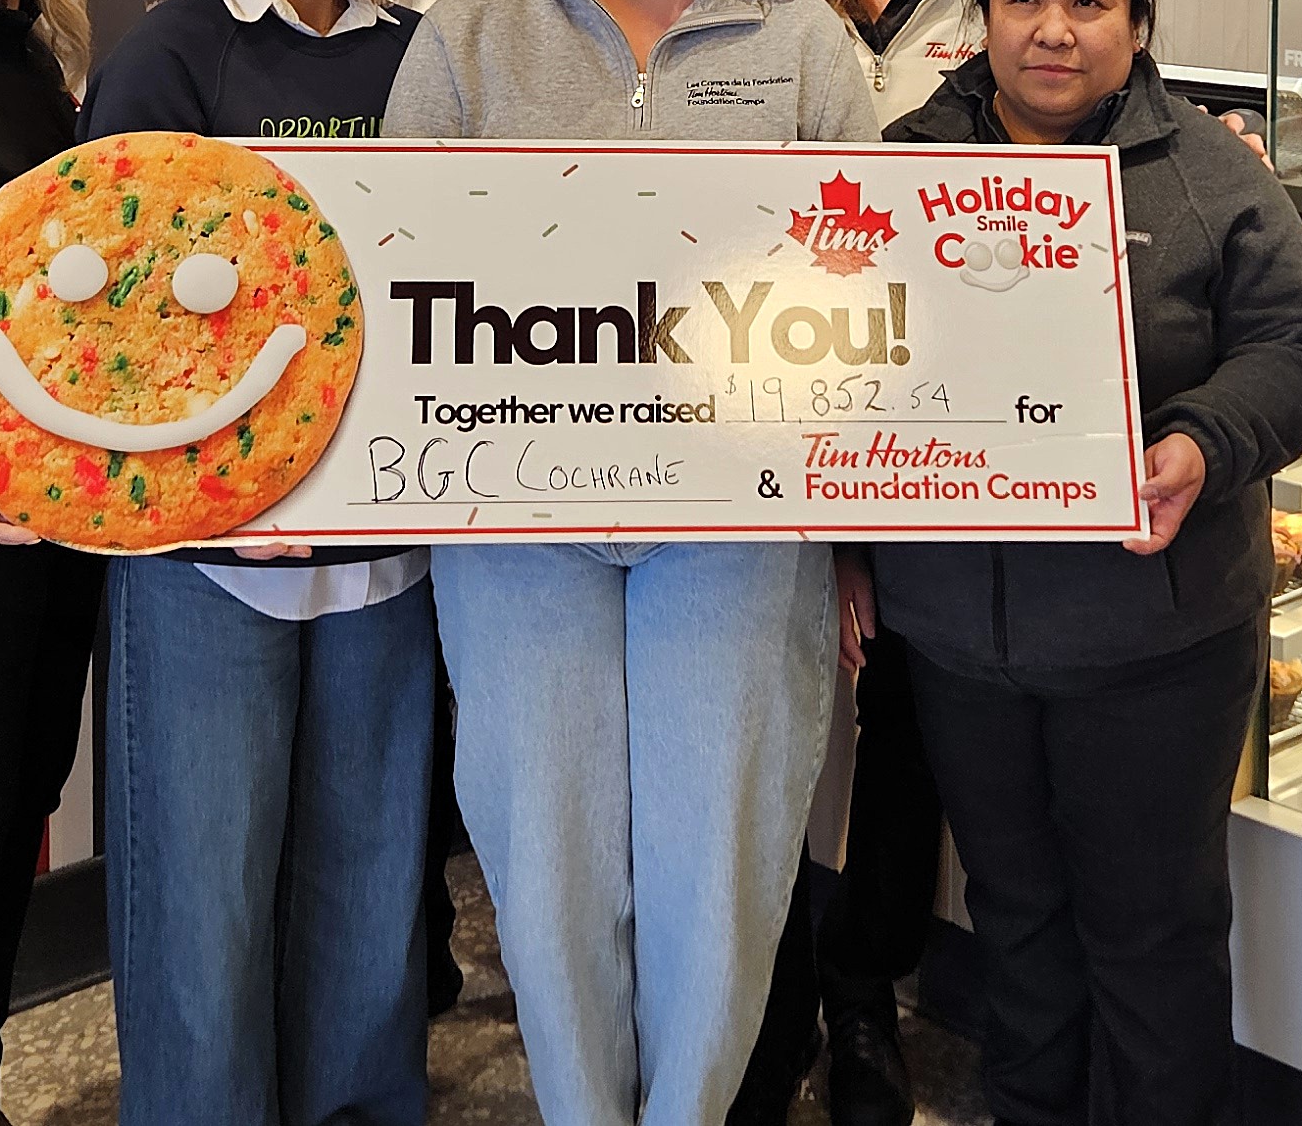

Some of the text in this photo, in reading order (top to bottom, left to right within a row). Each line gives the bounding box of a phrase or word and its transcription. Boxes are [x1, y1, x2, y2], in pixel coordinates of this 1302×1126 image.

[924, 42, 953, 60] Tim
[917, 175, 1091, 230] Holiday
[976, 215, 1028, 232] Smile
[802, 207, 888, 253] Tims
[389, 280, 911, 367] Thank You!
[413, 395, 565, 433] Together
[568, 402, 614, 425] we
[619, 394, 716, 425] raised
[1014, 394, 1064, 425] for
[368, 435, 500, 503] BGC
[756, 430, 988, 500] & Tim Hortons
[805, 473, 1097, 508] Foundation Camps
